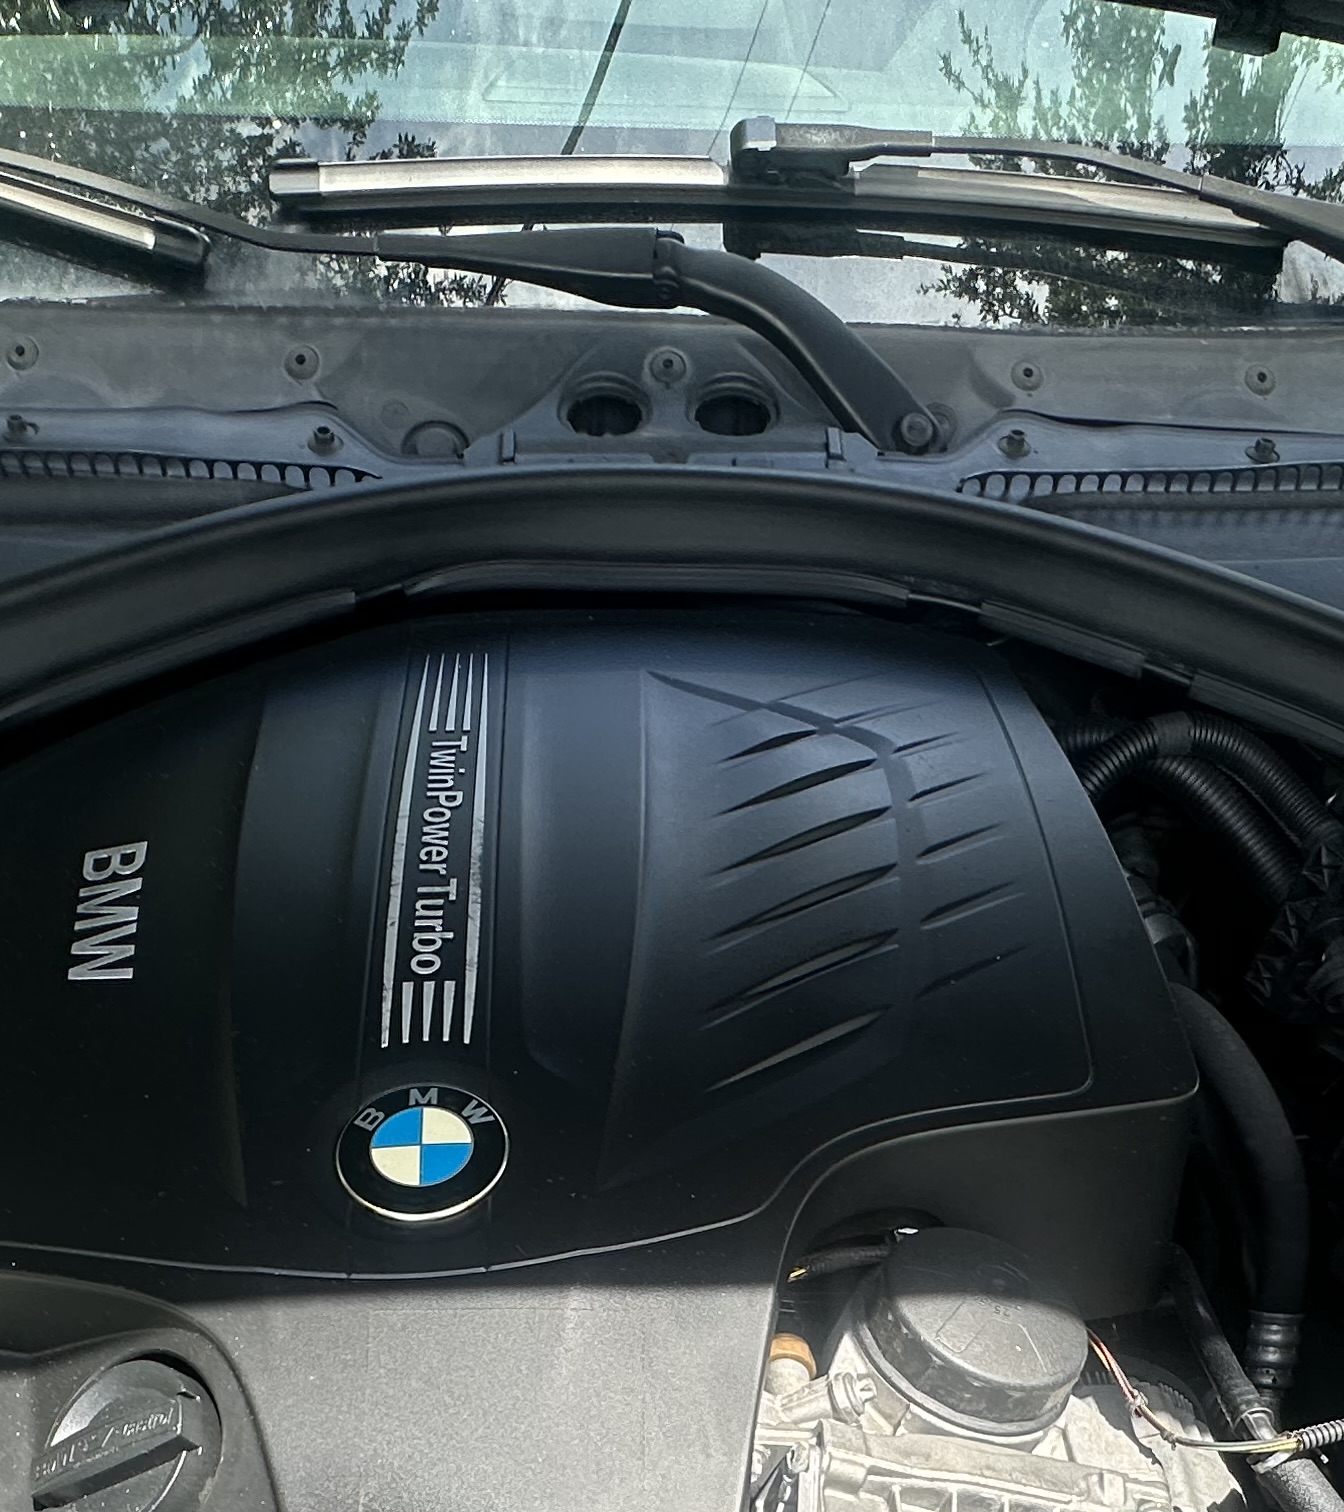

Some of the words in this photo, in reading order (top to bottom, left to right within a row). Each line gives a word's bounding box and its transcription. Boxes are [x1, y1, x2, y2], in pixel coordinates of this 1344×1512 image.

[419, 735, 468, 875] TwinPower
[67, 841, 148, 980] BMW
[410, 878, 458, 975] Turbo
[353, 1087, 496, 1132] BMW
